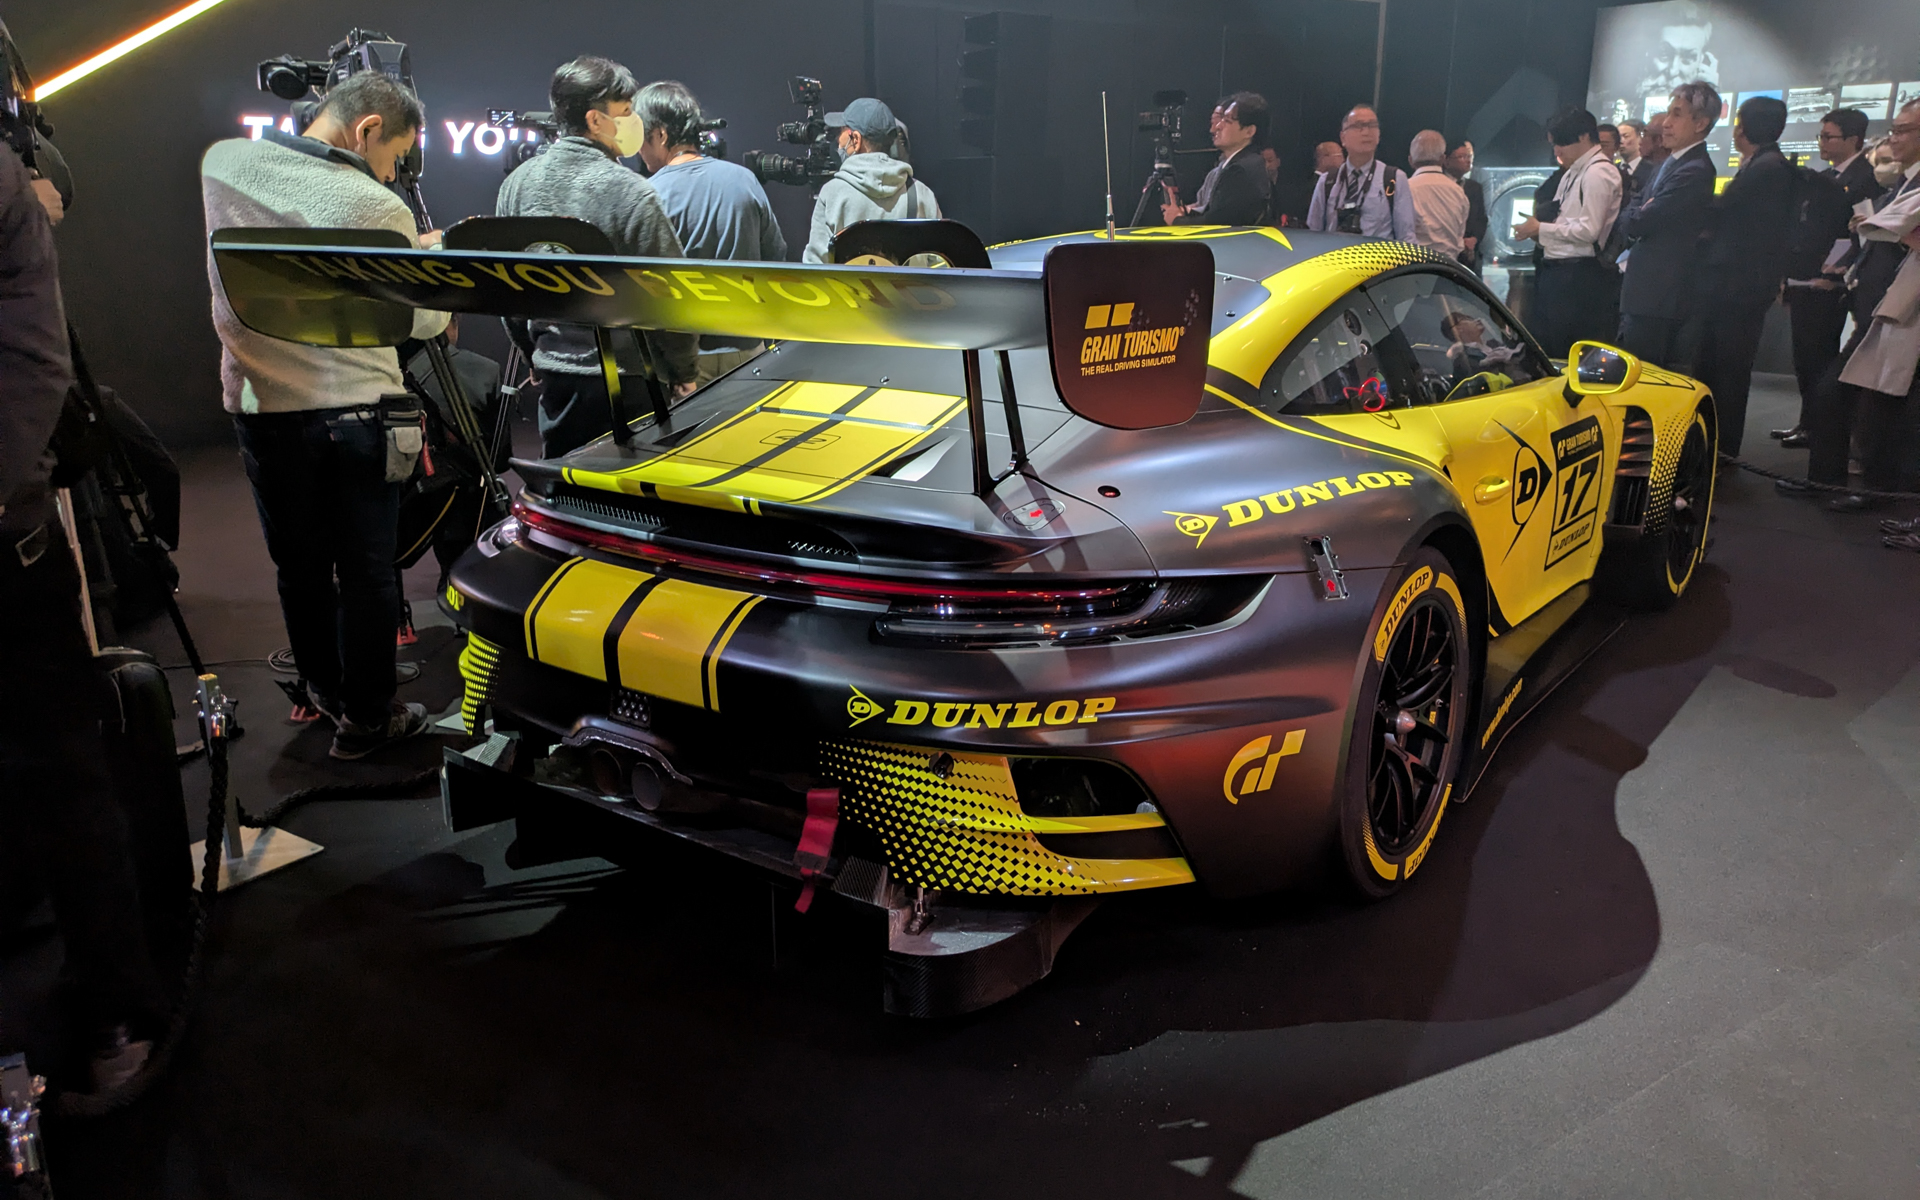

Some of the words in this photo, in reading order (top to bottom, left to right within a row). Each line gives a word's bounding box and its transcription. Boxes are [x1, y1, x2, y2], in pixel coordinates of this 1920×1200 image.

[446, 121, 536, 155] YO
[273, 254, 476, 288] TAKING
[470, 261, 616, 297] YOU
[624, 268, 957, 311] BEYOND
[1080, 334, 1121, 364] GRAN
[1081, 366, 1095, 377] THE
[1095, 364, 1114, 375] REAL
[1114, 360, 1141, 372] DRIVING
[1141, 355, 1176, 368] SIMULATOR
[1221, 471, 1415, 528] DUNLOP
[1558, 453, 1600, 526] 17
[1384, 571, 1430, 640] DUNLOP
[886, 696, 1117, 729] DUNLOP
